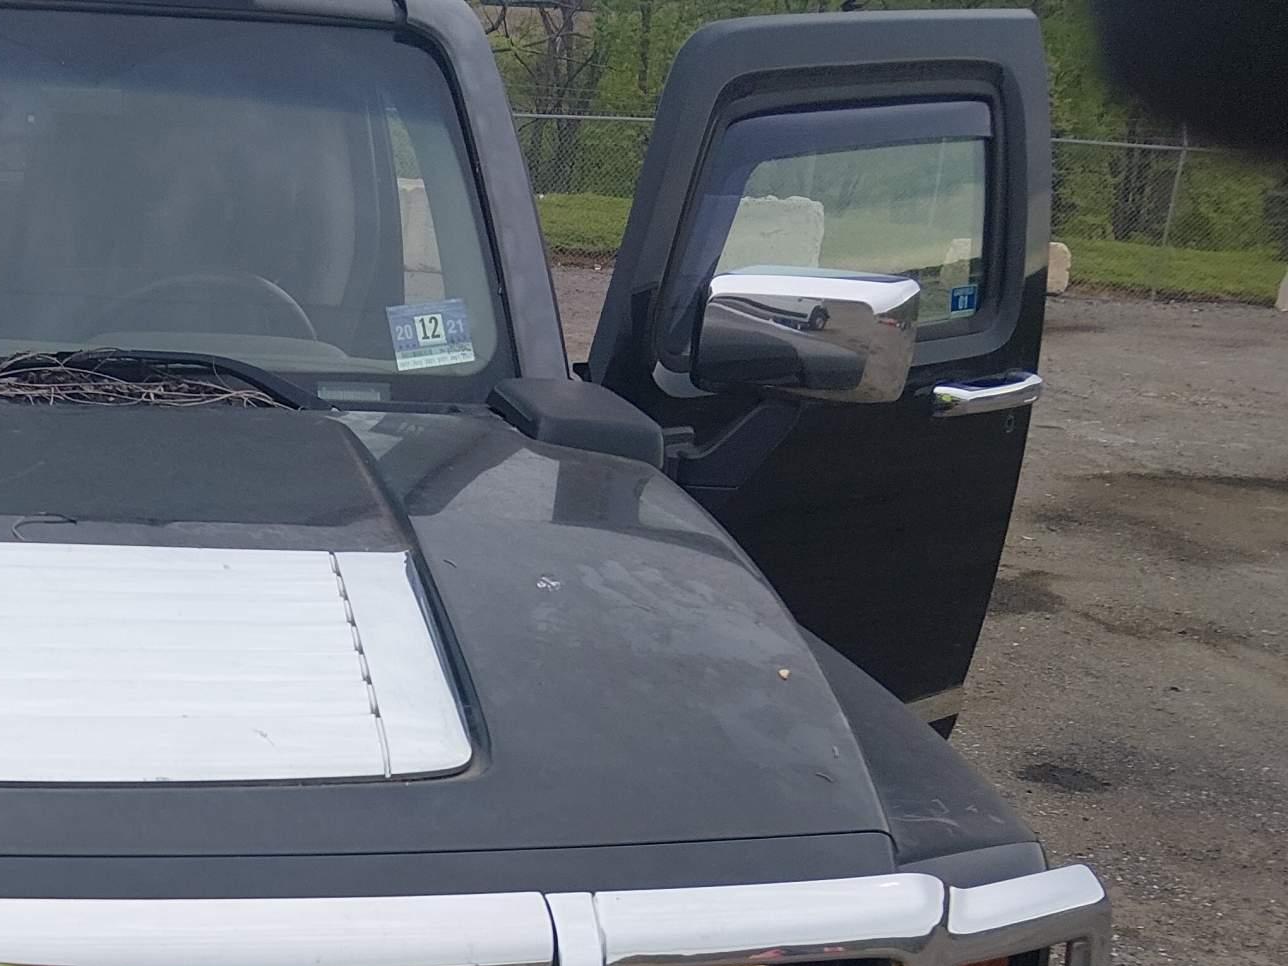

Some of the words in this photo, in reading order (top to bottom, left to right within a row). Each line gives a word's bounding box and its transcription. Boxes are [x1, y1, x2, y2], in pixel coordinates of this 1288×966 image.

[395, 324, 413, 341] 20
[419, 316, 441, 340] 12
[446, 319, 464, 334] 21
